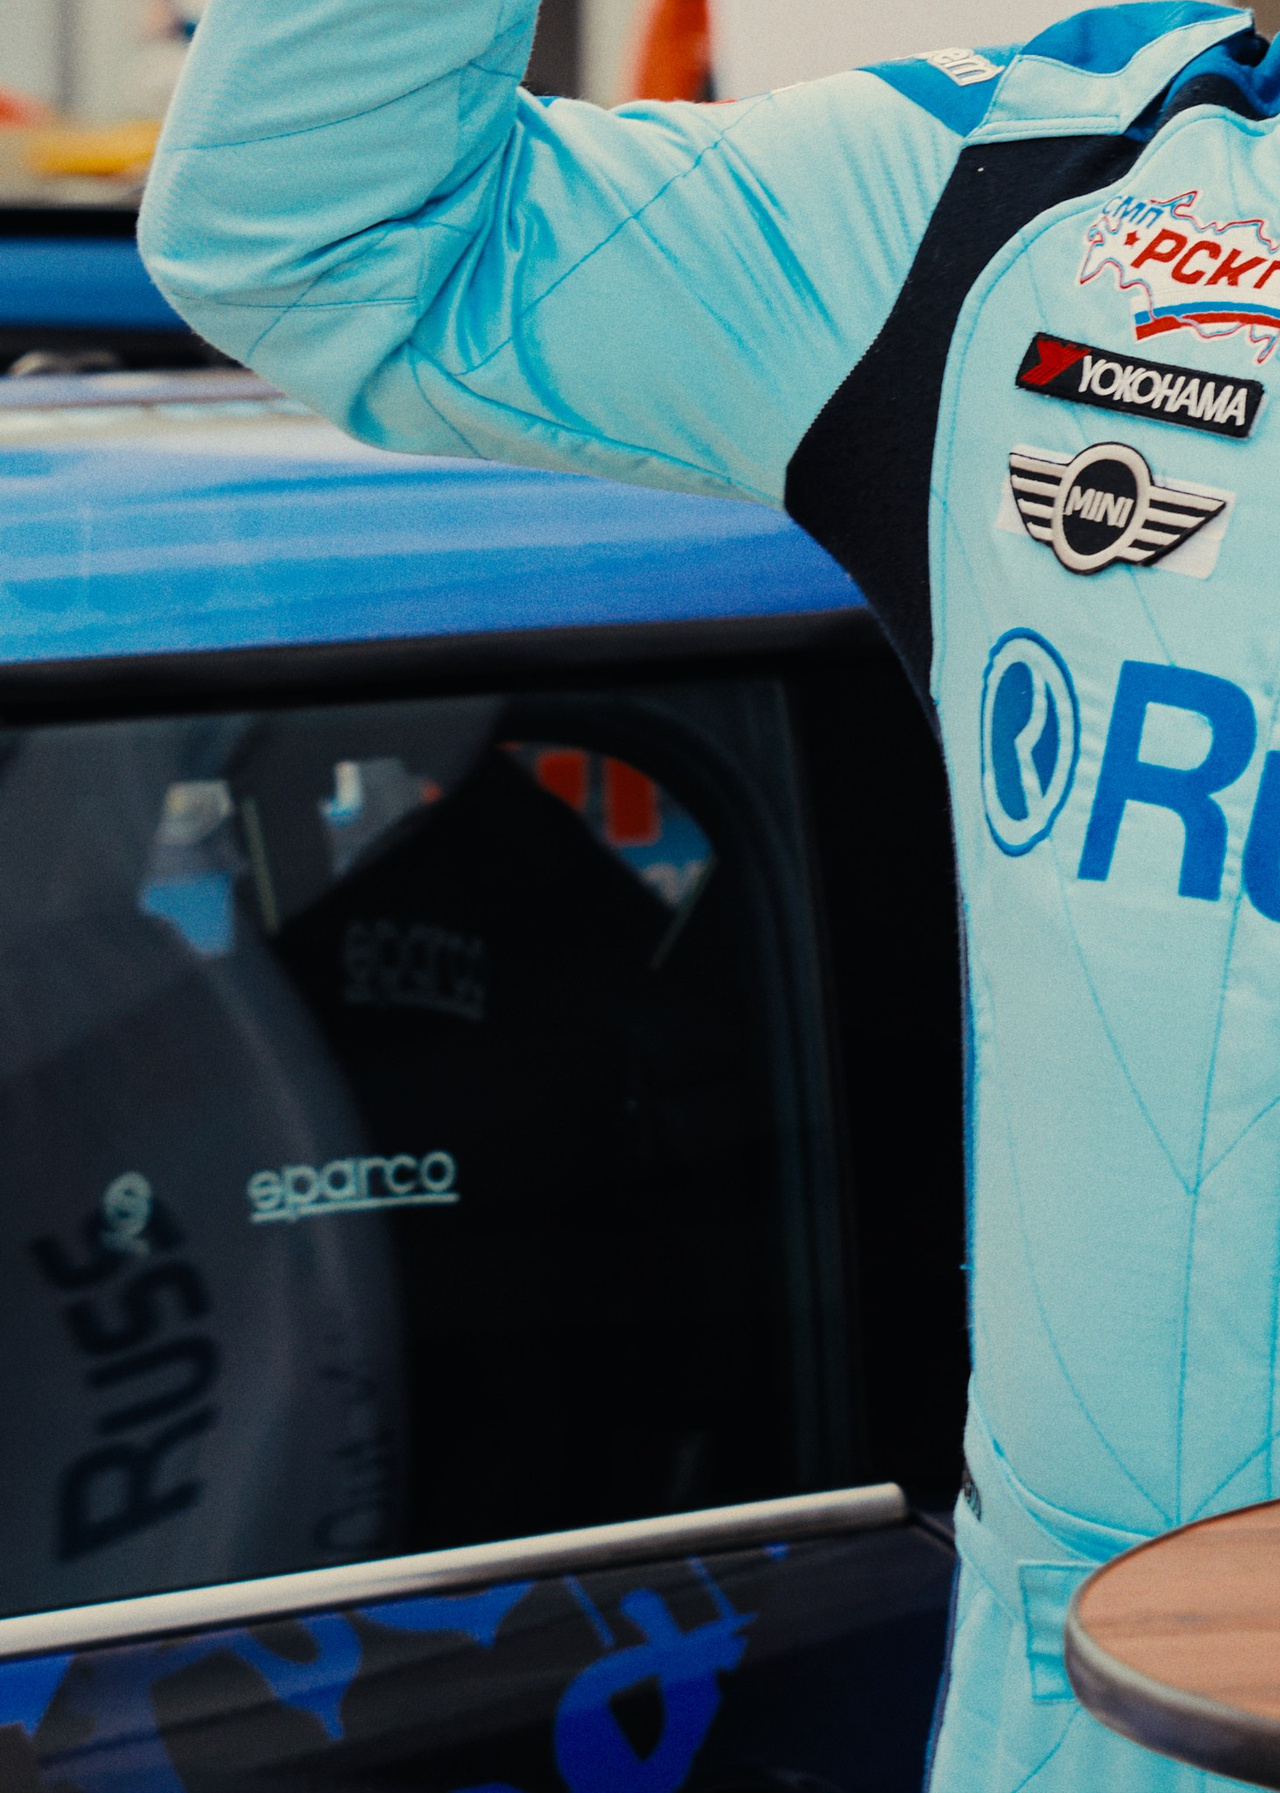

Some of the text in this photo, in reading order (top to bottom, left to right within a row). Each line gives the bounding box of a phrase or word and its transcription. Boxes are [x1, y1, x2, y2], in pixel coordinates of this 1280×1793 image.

[1078, 355, 1248, 426] YOKOHAMA
[1063, 485, 1135, 528] MINI
[247, 1151, 458, 1223] sparco
